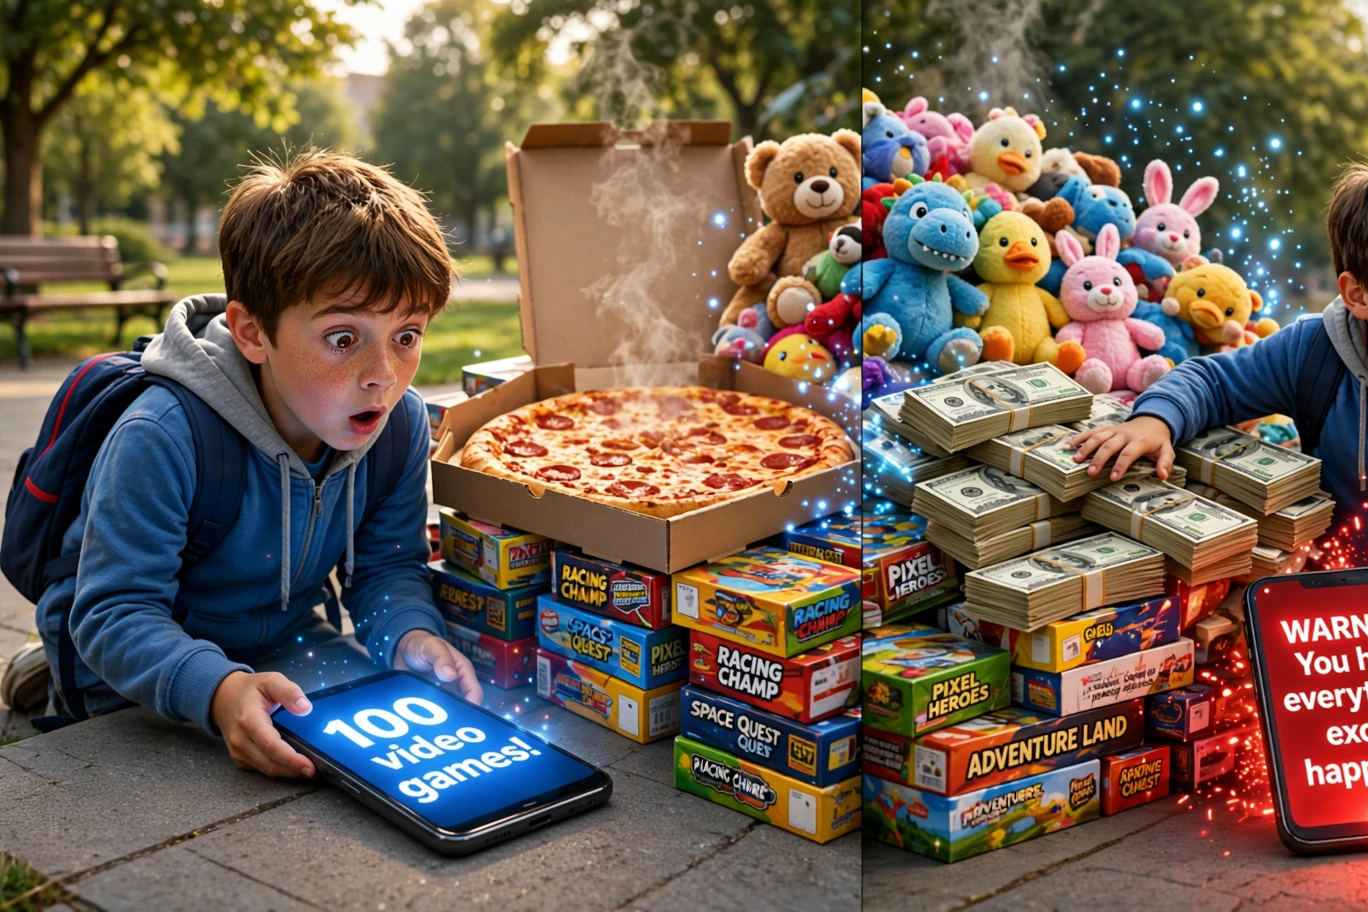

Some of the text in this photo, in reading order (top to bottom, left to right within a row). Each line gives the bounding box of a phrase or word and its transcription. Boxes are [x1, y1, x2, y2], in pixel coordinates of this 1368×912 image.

[562, 565, 607, 590] RACING
[888, 553, 936, 591] PIXEL
[794, 594, 850, 627] RACING
[717, 645, 783, 682] RACING
[1294, 650, 1350, 676] You
[718, 667, 779, 699] CHAMP
[928, 684, 990, 719] HEROES
[932, 672, 980, 701] PIXEL
[323, 696, 449, 749] 100
[690, 700, 734, 729] SPACE
[737, 715, 781, 746] QUEST
[371, 726, 487, 771] video
[967, 727, 1078, 779] ADVENTURE
[1083, 715, 1128, 747] LAND
[399, 736, 542, 804] games!
